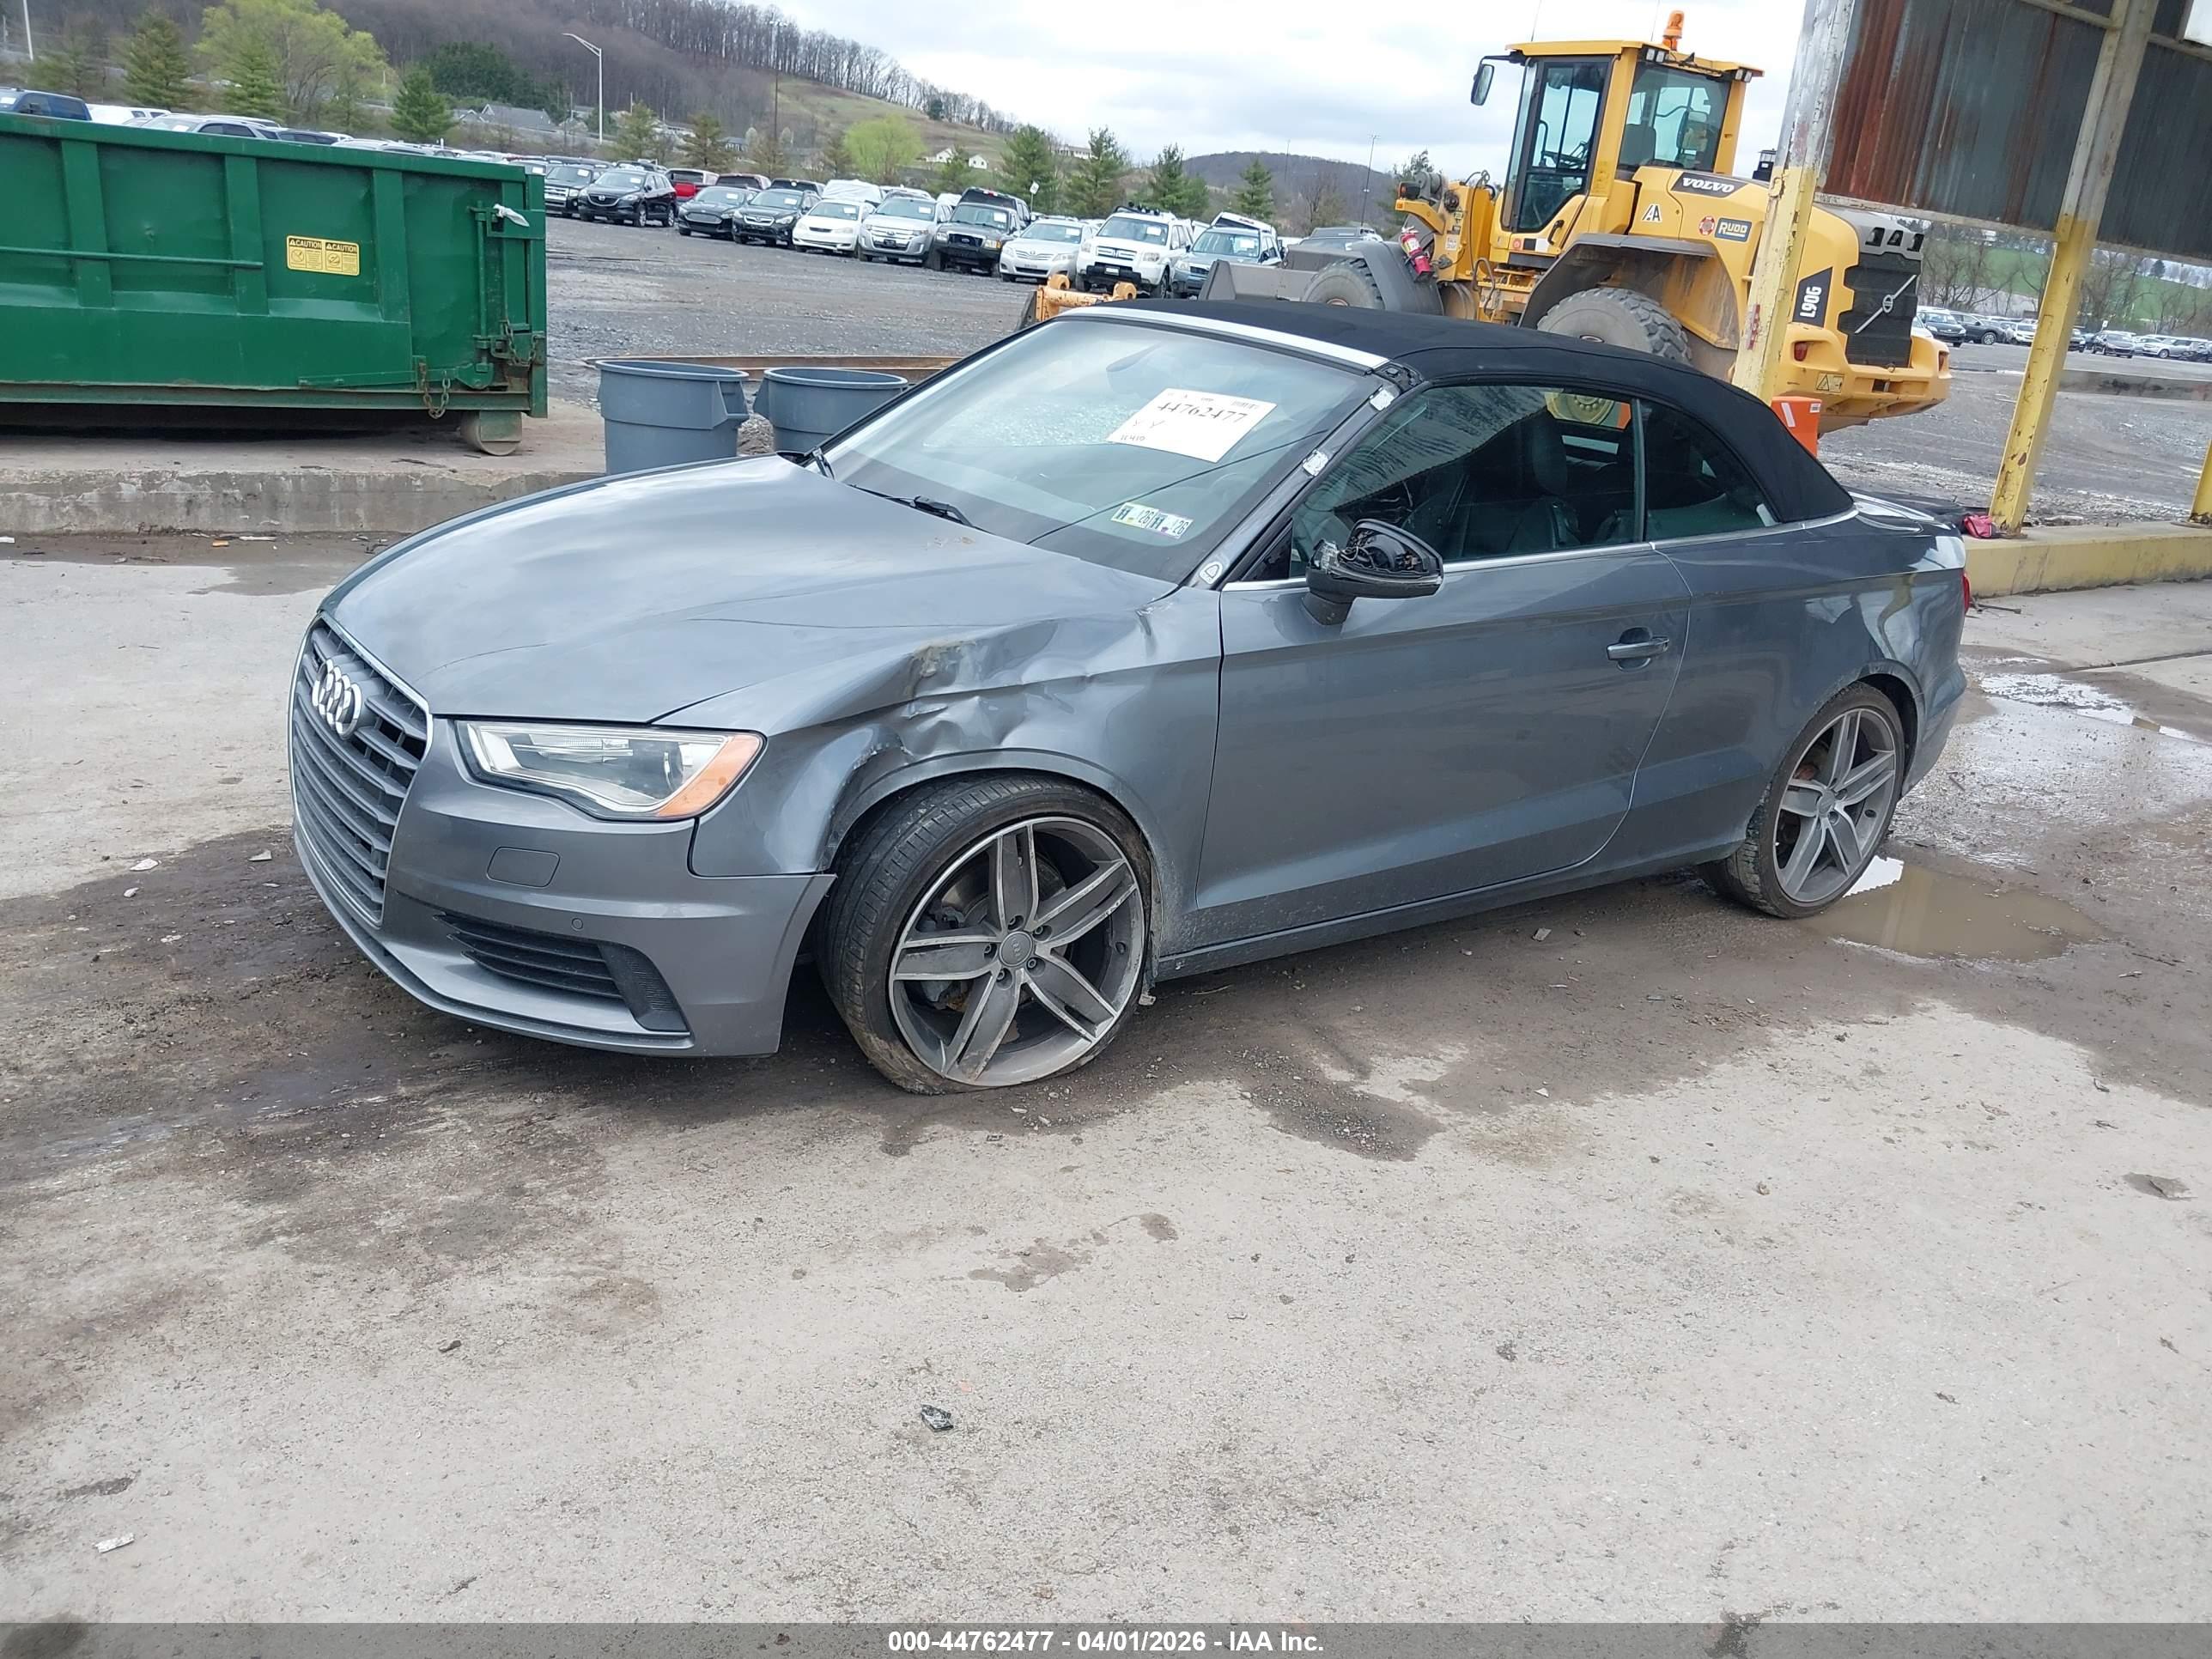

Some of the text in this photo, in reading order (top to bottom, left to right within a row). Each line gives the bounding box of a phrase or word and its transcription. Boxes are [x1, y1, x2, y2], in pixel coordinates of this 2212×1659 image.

[1682, 177, 1735, 193] VOLVO
[1718, 222, 1748, 237] RUDD
[295, 240, 322, 249] CAUTION
[331, 244, 357, 253] CAUTION
[1799, 286, 1822, 318] L90G
[1157, 402, 1248, 422] 44762477
